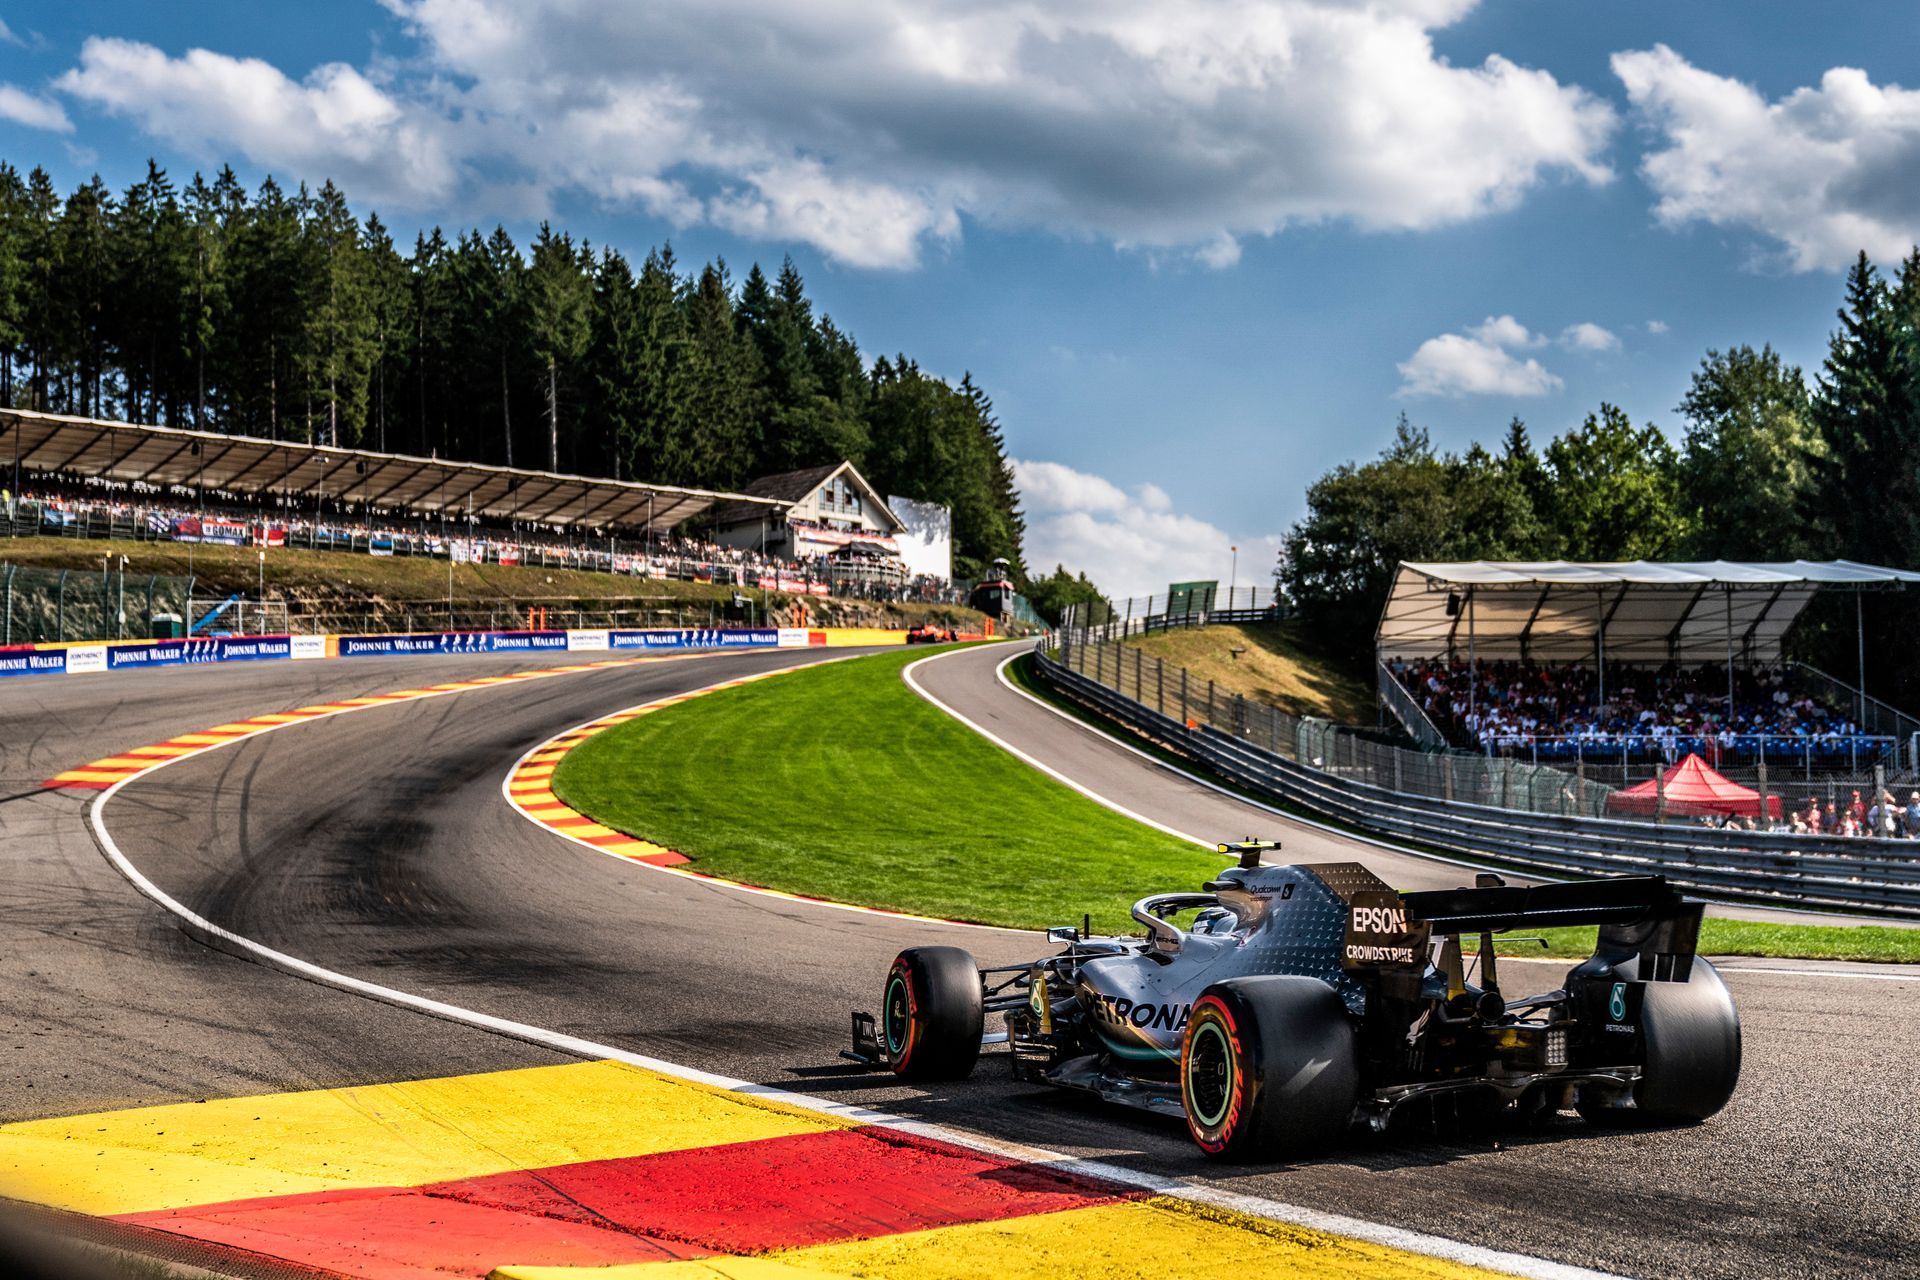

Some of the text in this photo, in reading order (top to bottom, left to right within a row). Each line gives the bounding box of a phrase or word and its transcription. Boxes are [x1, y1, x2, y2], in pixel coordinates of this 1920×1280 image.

[492, 636, 565, 649] JOHNNIE WALKER
[613, 634, 677, 646] JOHNNIE WALKER
[721, 632, 750, 644] JOHNNIE
[751, 632, 777, 643] WALKER
[223, 642, 289, 658] JOHNNIE WALKER
[347, 639, 434, 654] JOHNNIE WALKER
[29, 656, 64, 669] WALKER
[112, 650, 147, 666] JOHNNIE
[149, 648, 180, 660] WALKER
[1353, 907, 1407, 934] EPSON
[1346, 944, 1413, 963] CROWDSTRIKE
[1605, 1024, 1635, 1033] PETRONAS
